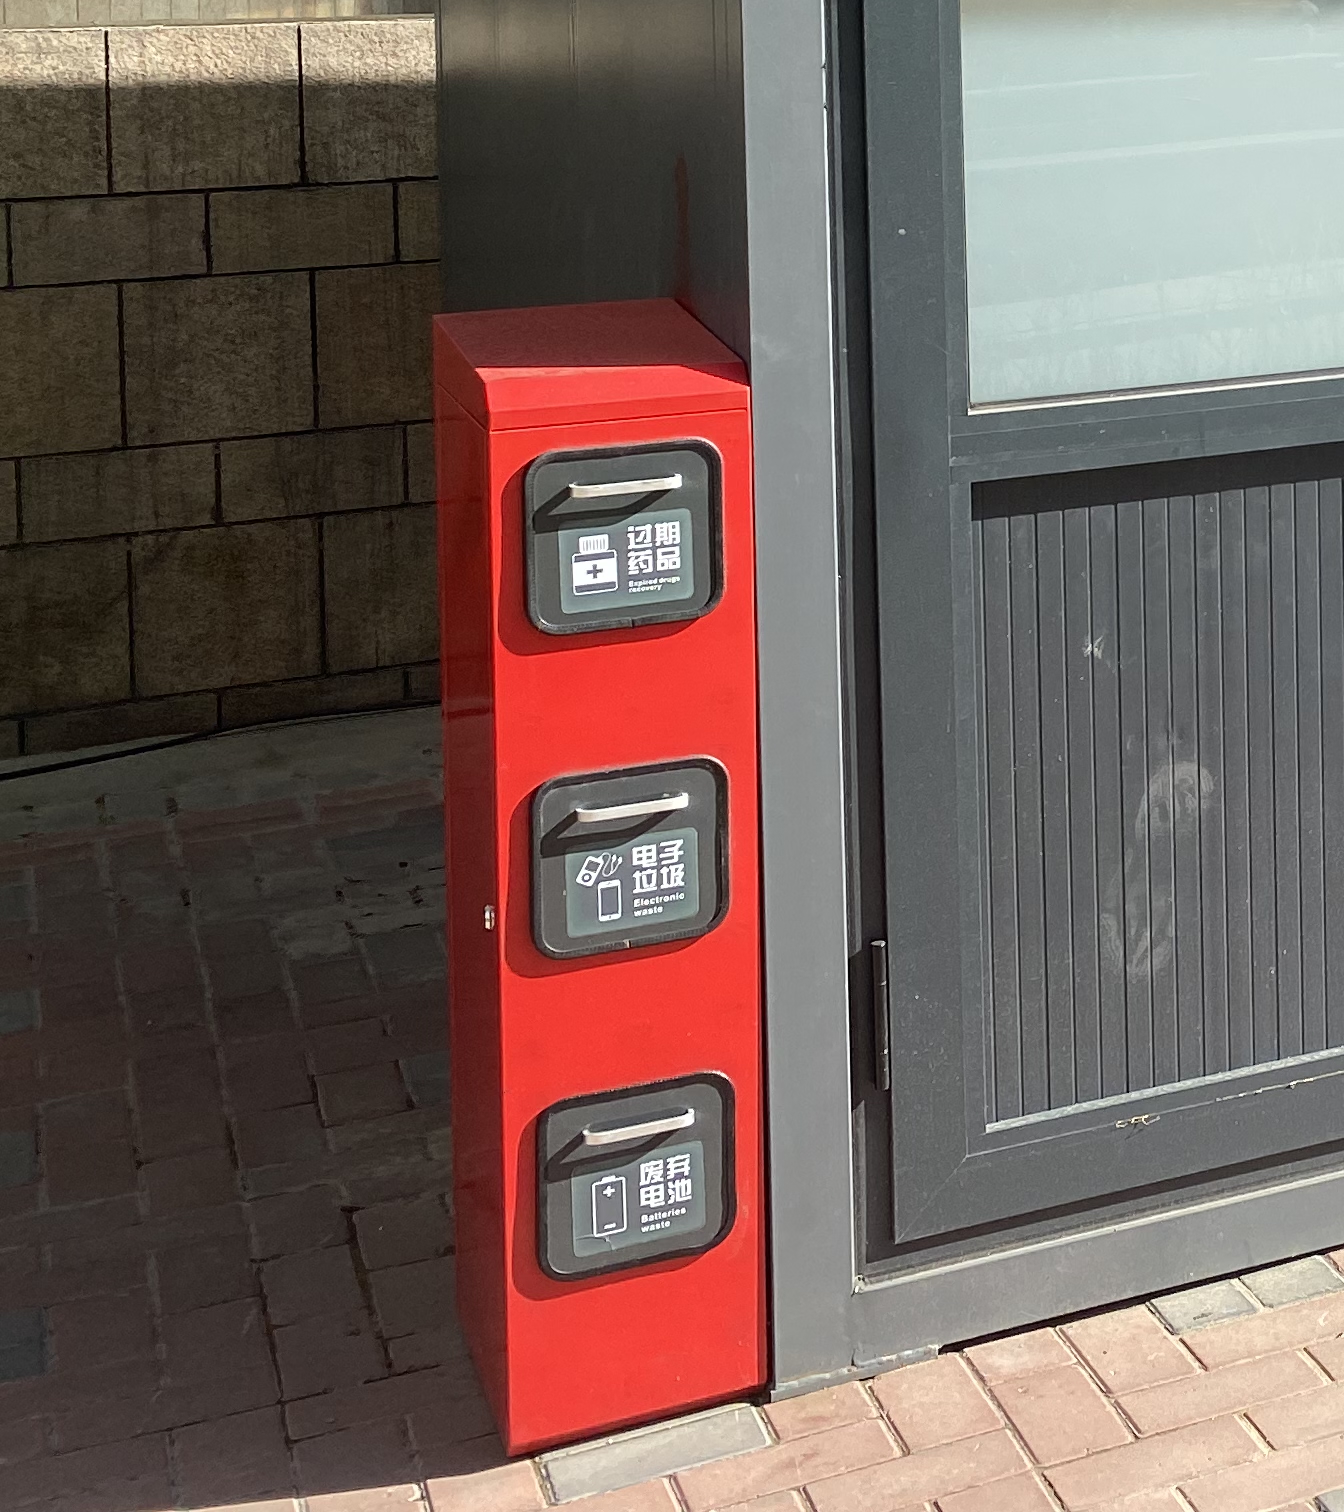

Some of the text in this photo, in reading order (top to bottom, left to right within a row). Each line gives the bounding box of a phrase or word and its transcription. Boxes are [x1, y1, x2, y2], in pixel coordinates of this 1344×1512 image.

[627, 521, 681, 549] 过期
[627, 546, 681, 575] 药品
[631, 838, 685, 868] 电子
[632, 863, 686, 894] 垃圾
[633, 892, 685, 908] Electronic
[633, 906, 664, 917] waste
[639, 1153, 691, 1187] 废弃
[639, 1178, 693, 1208] 电池
[640, 1207, 687, 1224] Batteries
[640, 1220, 671, 1233] waste
